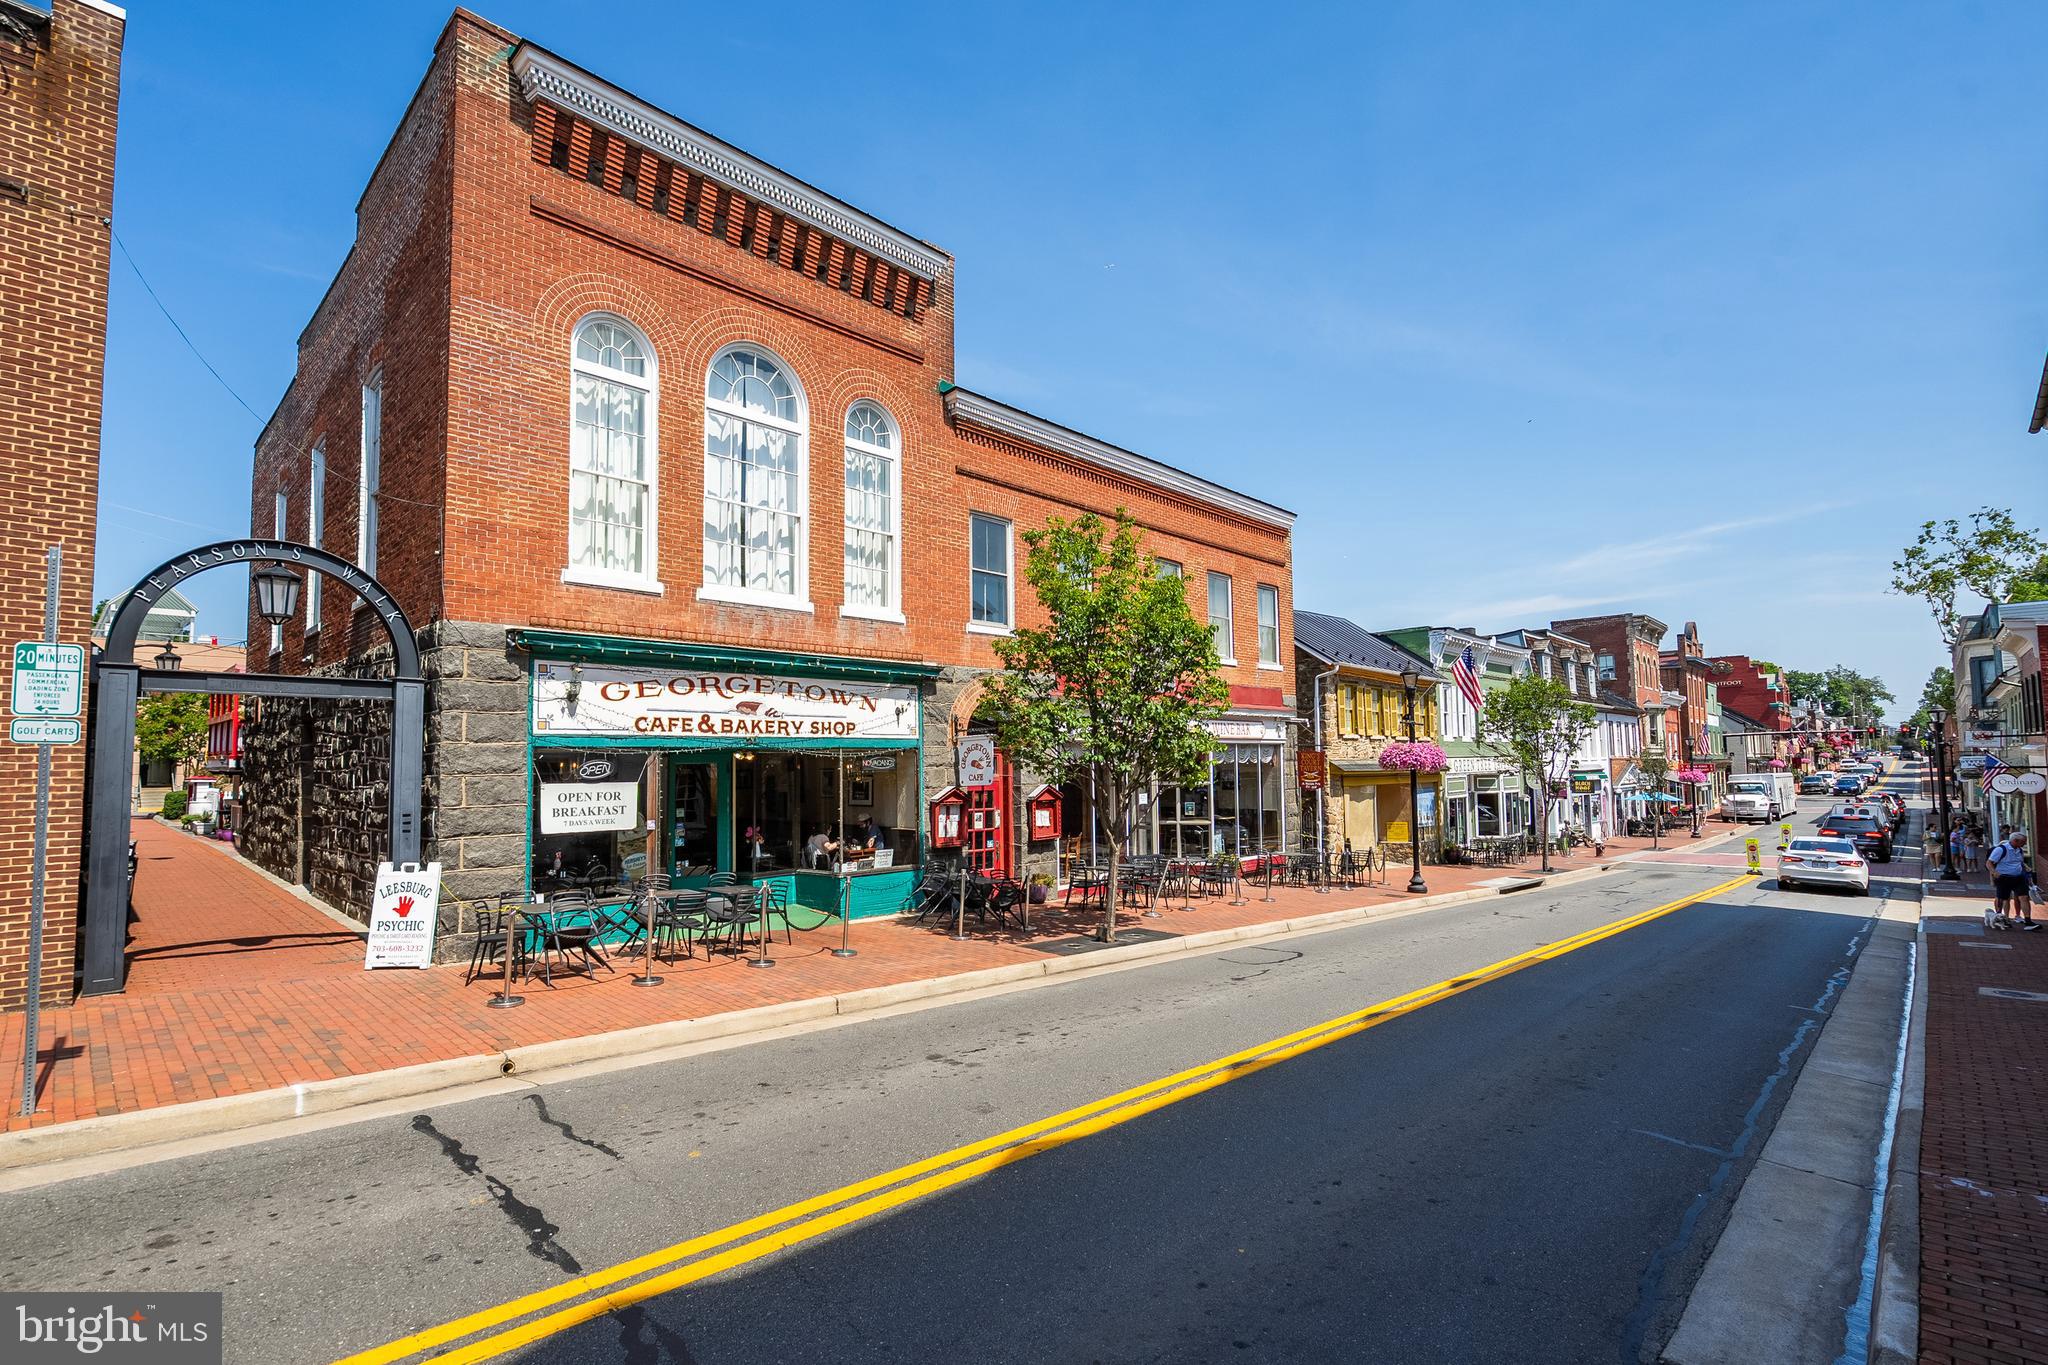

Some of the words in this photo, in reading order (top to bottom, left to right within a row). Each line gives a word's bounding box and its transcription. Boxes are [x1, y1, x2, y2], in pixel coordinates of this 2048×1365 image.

[134, 543, 302, 603] PEARSON'S
[341, 564, 402, 624] WALK
[17, 650, 36, 664] 20
[38, 654, 78, 664] MINUTES
[601, 676, 879, 713] GEORGETOWN
[17, 727, 42, 735] GOLF
[45, 727, 74, 735] CARTS
[634, 716, 693, 733] CAFE
[697, 713, 718, 734] &
[721, 718, 804, 736] BAKERY
[810, 721, 856, 736] SHOP
[1211, 722, 1235, 735] WINE
[1236, 723, 1251, 736] BAR
[961, 743, 992, 770] GEORGETOWN
[580, 763, 611, 776] OPEN
[1453, 759, 1475, 772] GREEN
[968, 773, 984, 781] CAFE
[557, 791, 592, 802] OPEN
[596, 791, 621, 802] FOR
[552, 805, 627, 818] BREAKFAST
[379, 881, 432, 899] LEESBURG
[377, 920, 425, 931] PSYCHIC
[372, 944, 424, 952] 703-608-3232
